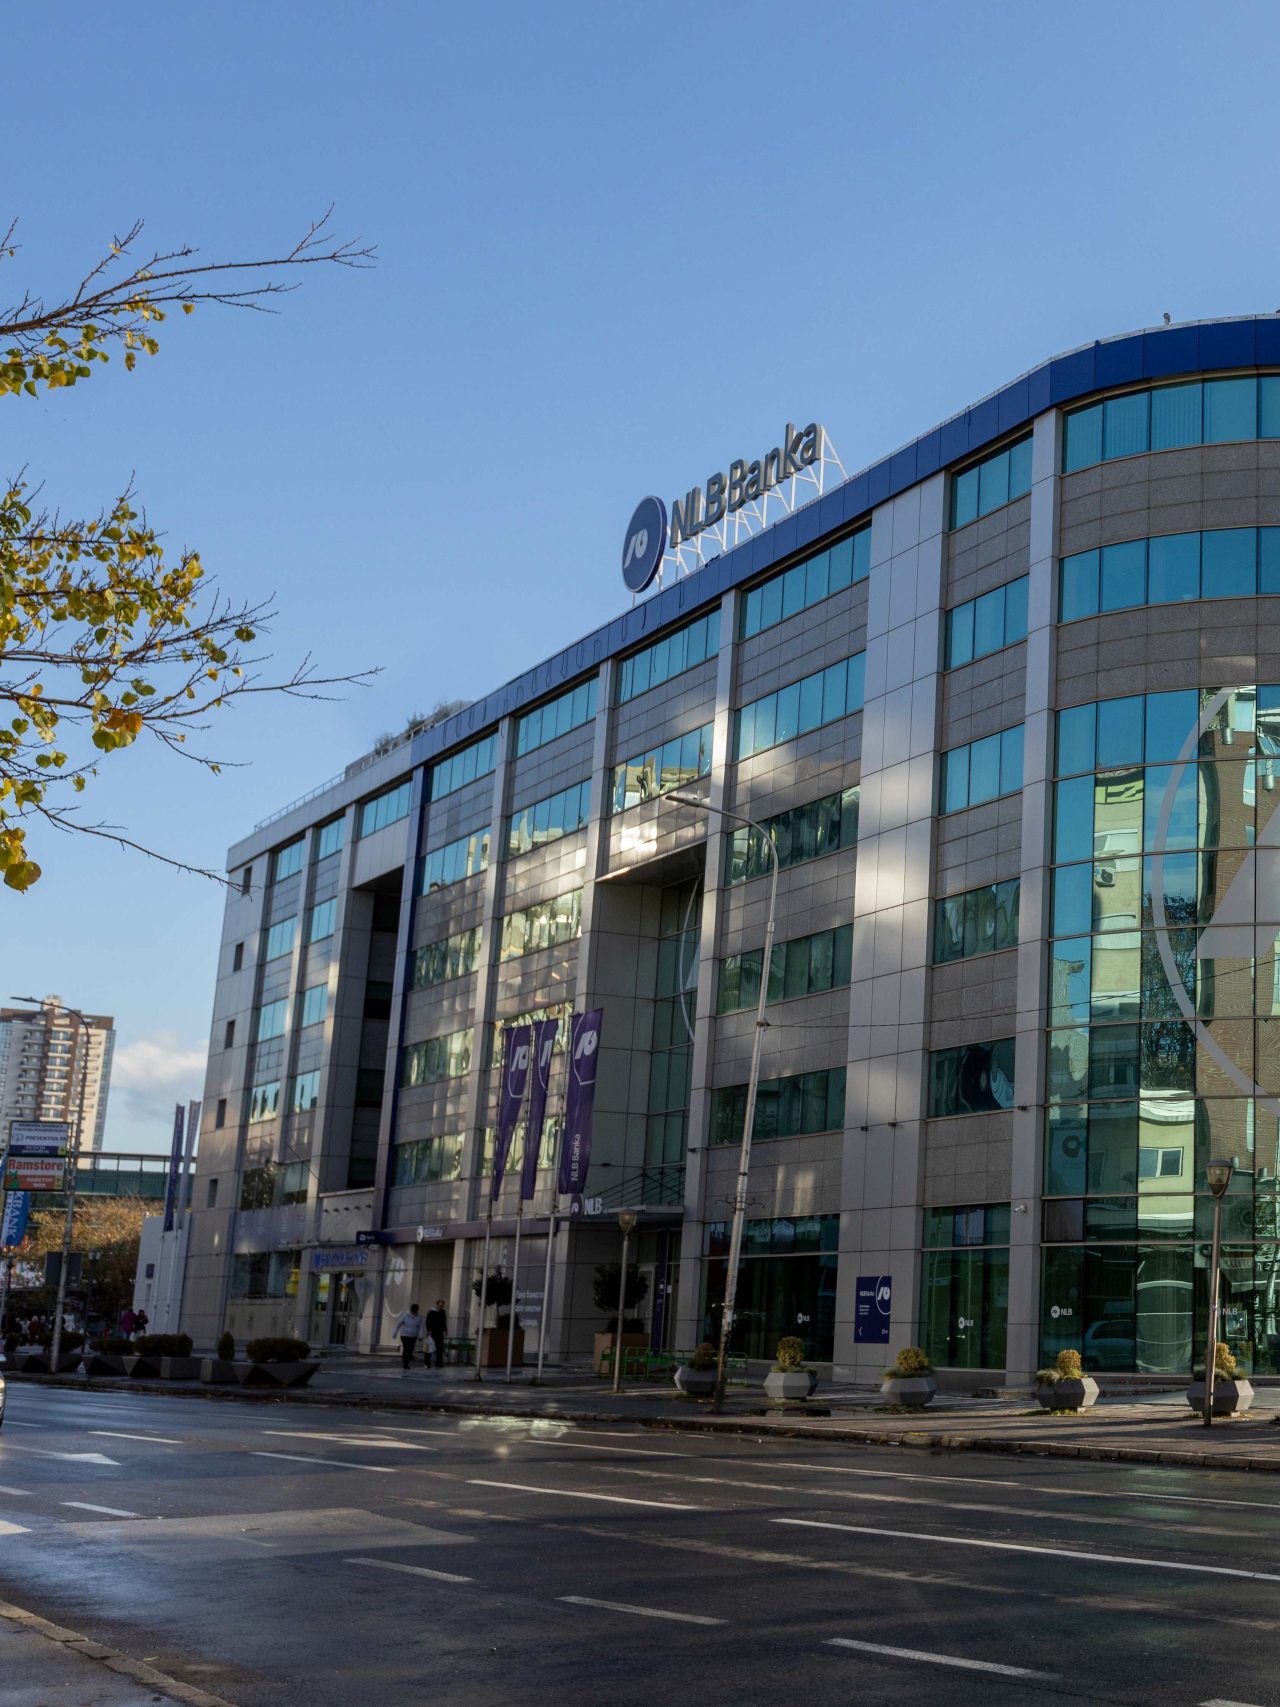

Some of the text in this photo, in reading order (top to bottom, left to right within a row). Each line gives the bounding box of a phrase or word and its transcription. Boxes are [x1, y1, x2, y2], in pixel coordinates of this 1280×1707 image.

[669, 422, 823, 549] NLB Banka
[8, 1159, 64, 1171] Ramstore
[571, 1133, 581, 1181] NLB Banka
[585, 1197, 602, 1215] NLB
[1060, 1308, 1073, 1316] NLB
